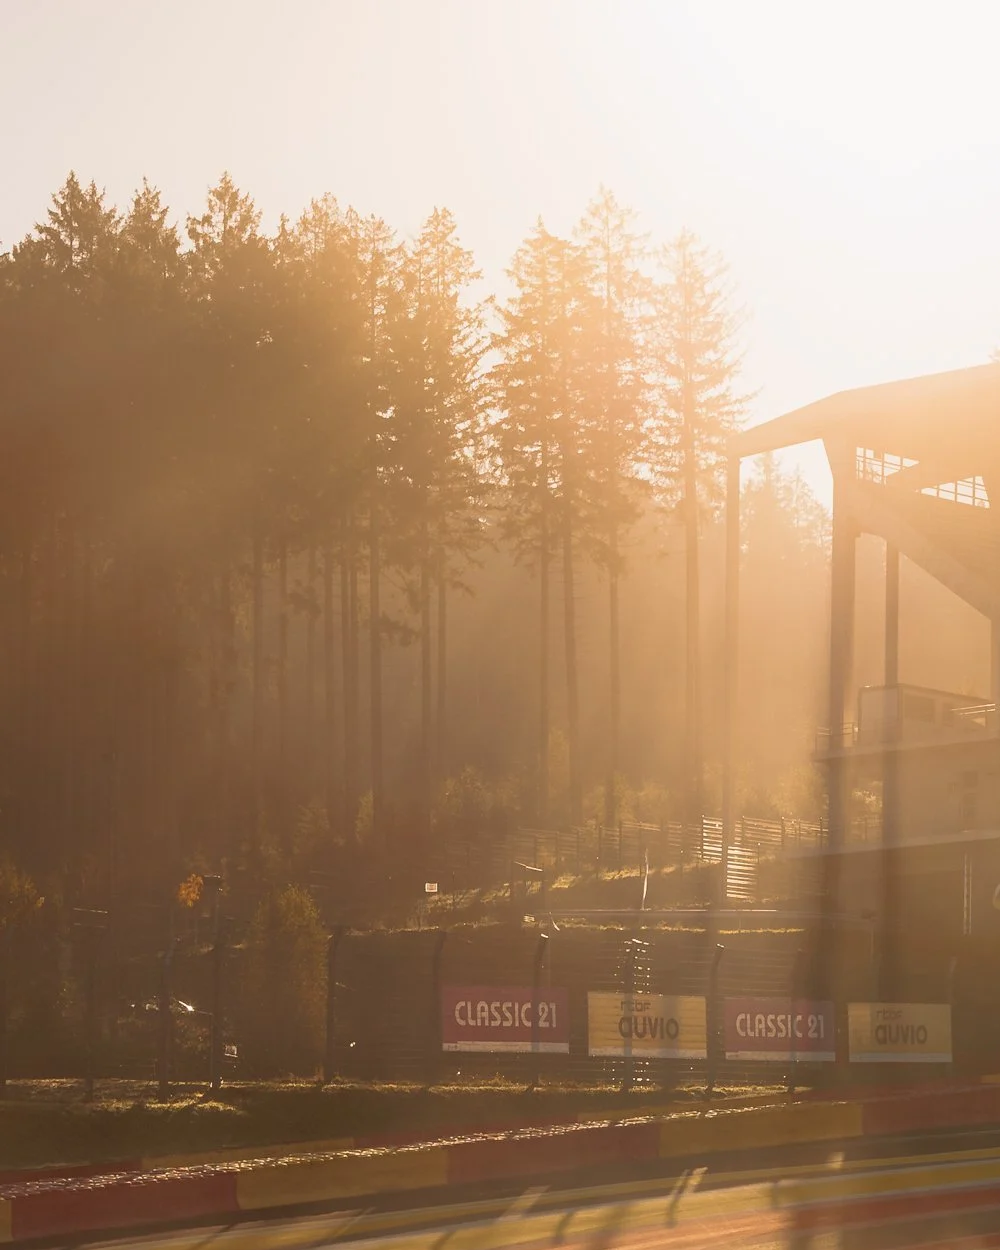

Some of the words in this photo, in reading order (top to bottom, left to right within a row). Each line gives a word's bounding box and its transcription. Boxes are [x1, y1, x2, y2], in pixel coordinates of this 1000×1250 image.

[455, 1000, 532, 1027] CLASSIC
[538, 1001, 557, 1028] 21
[735, 1012, 804, 1038] CLASSIC
[808, 1014, 825, 1038] 21
